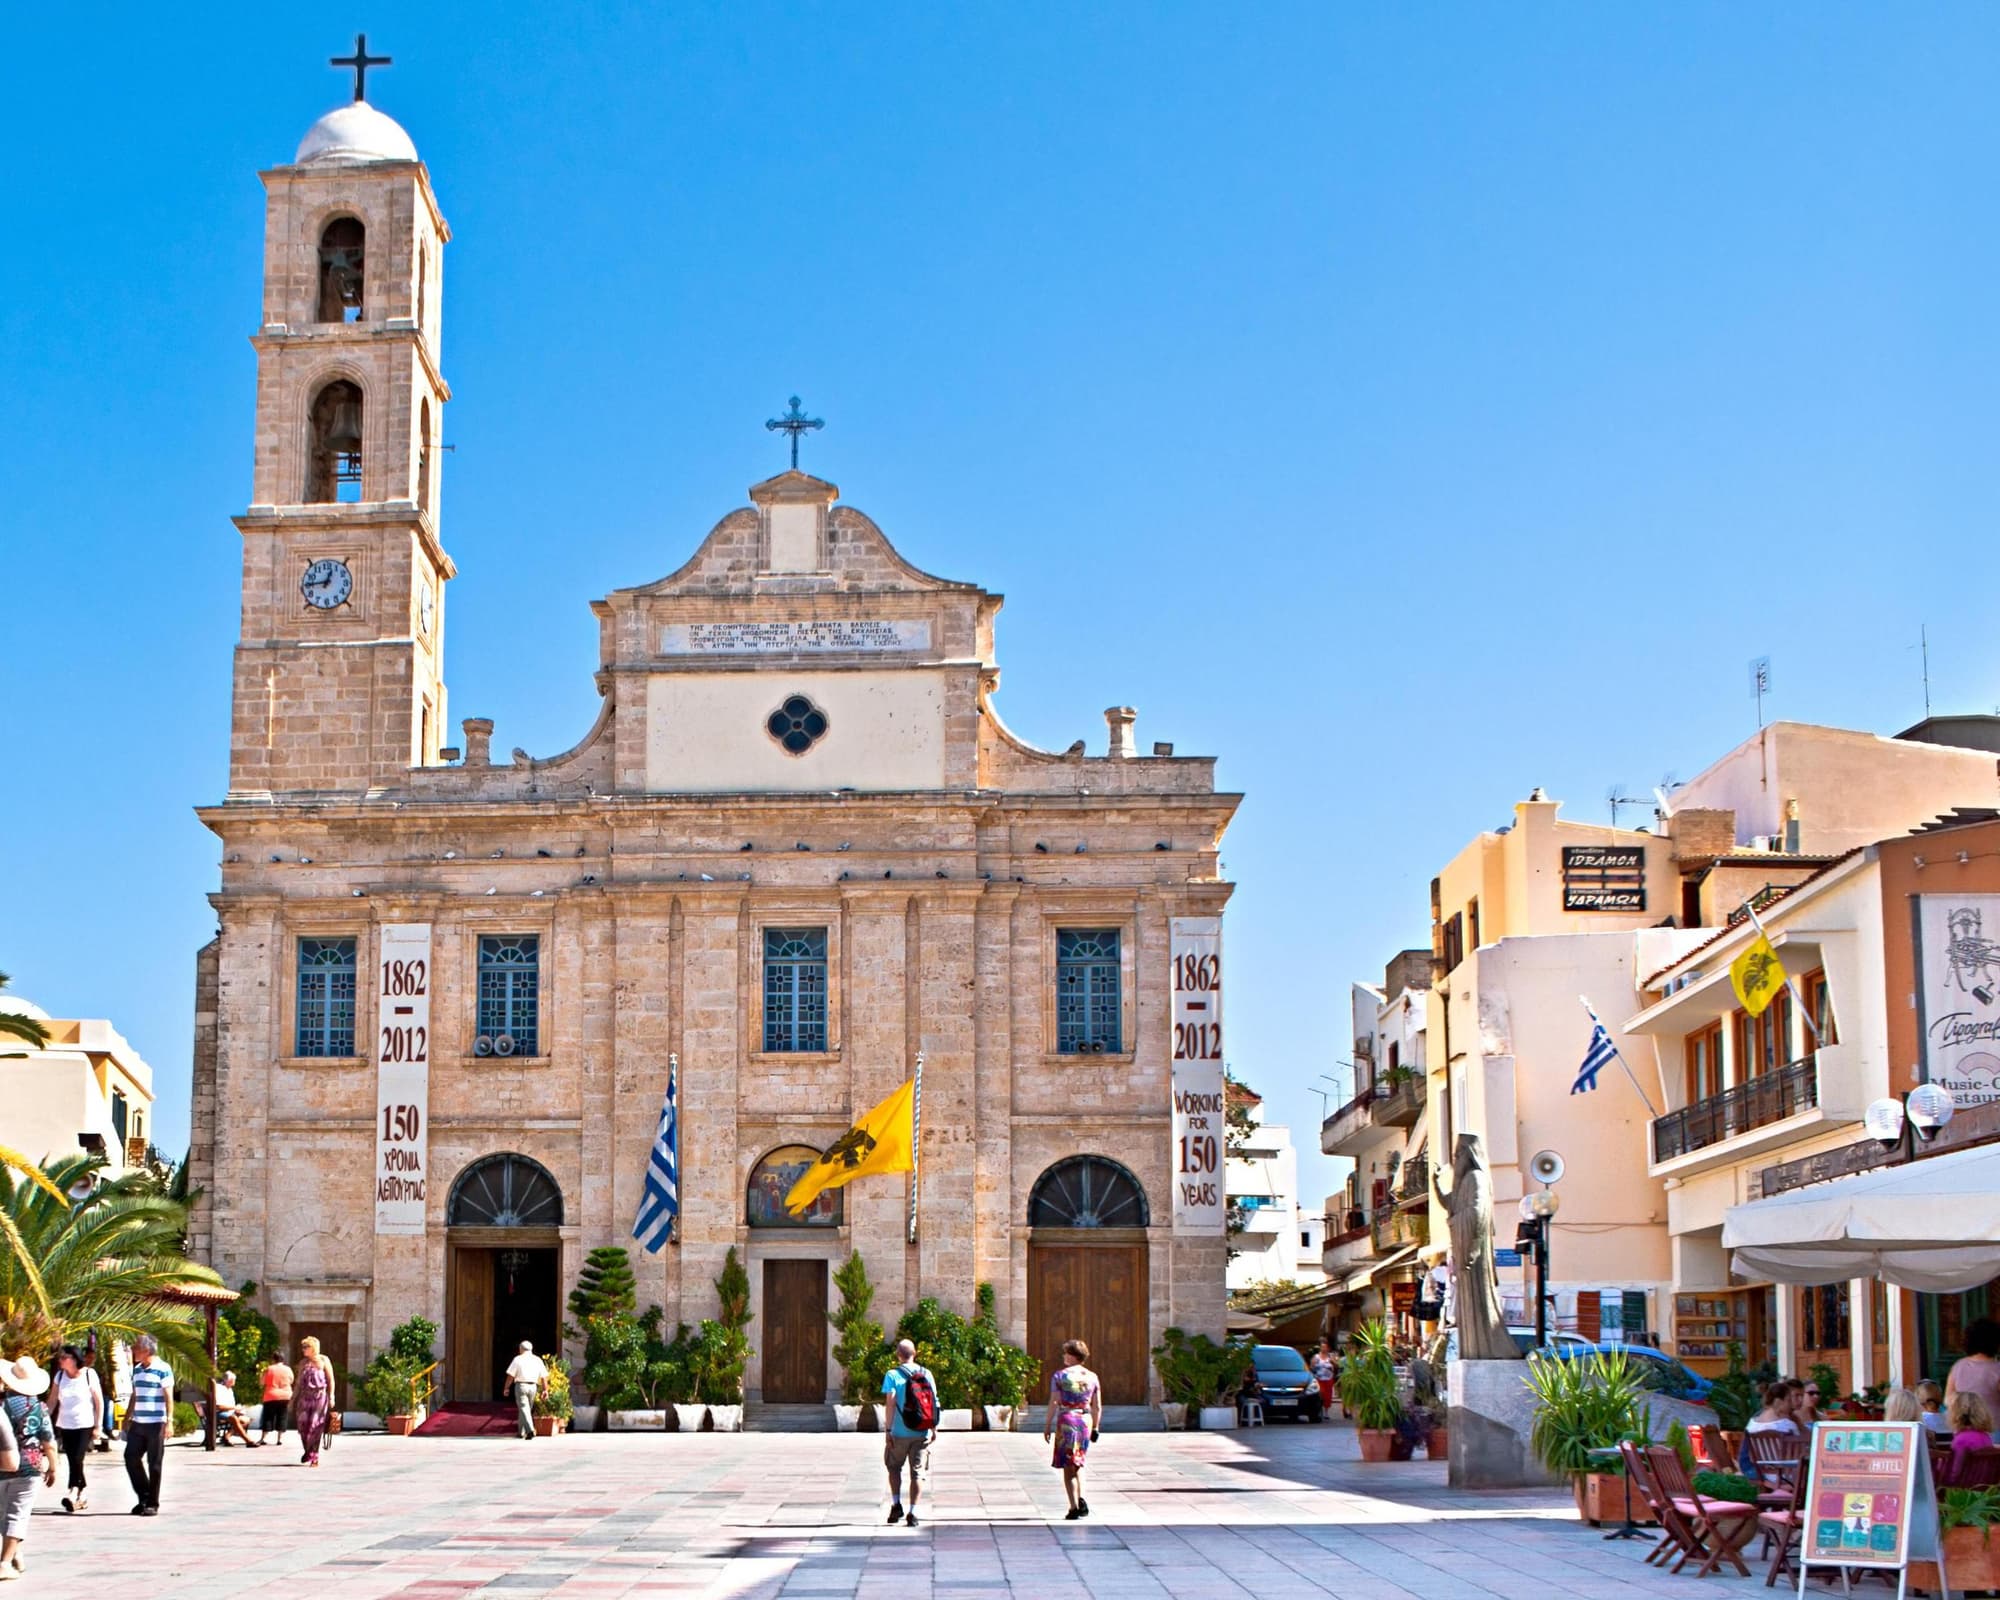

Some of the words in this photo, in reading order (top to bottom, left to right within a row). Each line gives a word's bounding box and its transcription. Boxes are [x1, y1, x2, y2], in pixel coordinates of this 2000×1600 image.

[1568, 855, 1638, 866] IDRAMON
[381, 960, 426, 996] 1862
[1173, 954, 1220, 992] 1862
[380, 1026, 426, 1063] 2012
[1173, 1022, 1222, 1060] 2012
[1174, 1089, 1223, 1115] WORKING
[382, 1104, 420, 1142] 150
[1189, 1117, 1209, 1130] FOR
[384, 1148, 420, 1172] ΧΡΟΝΙΑ
[1179, 1135, 1217, 1174] 150
[1180, 1182, 1217, 1207] YEARS
